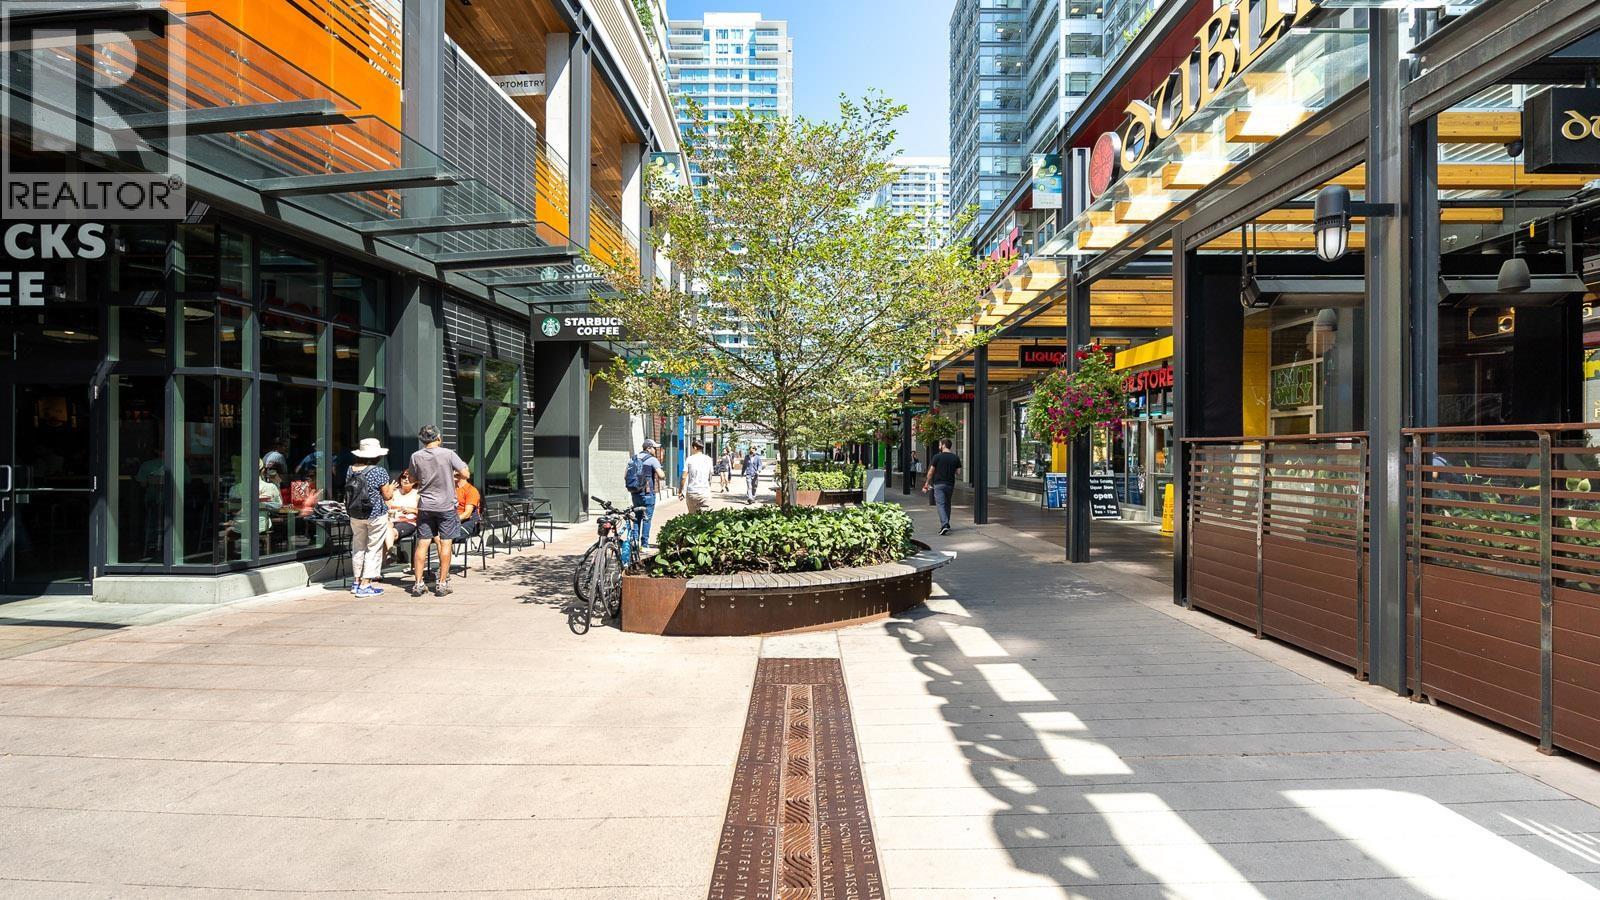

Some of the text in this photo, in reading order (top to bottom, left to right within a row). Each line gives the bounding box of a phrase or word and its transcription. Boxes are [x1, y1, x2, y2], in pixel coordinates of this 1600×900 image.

[4, 223, 106, 260] CKS
[576, 326, 620, 336] COFFEE
[1024, 351, 1067, 363] LIQUO
[1137, 365, 1174, 391] STORE
[1275, 366, 1312, 389] EXIT
[1275, 383, 1312, 406] ONLY
[1093, 493, 1113, 501] open
